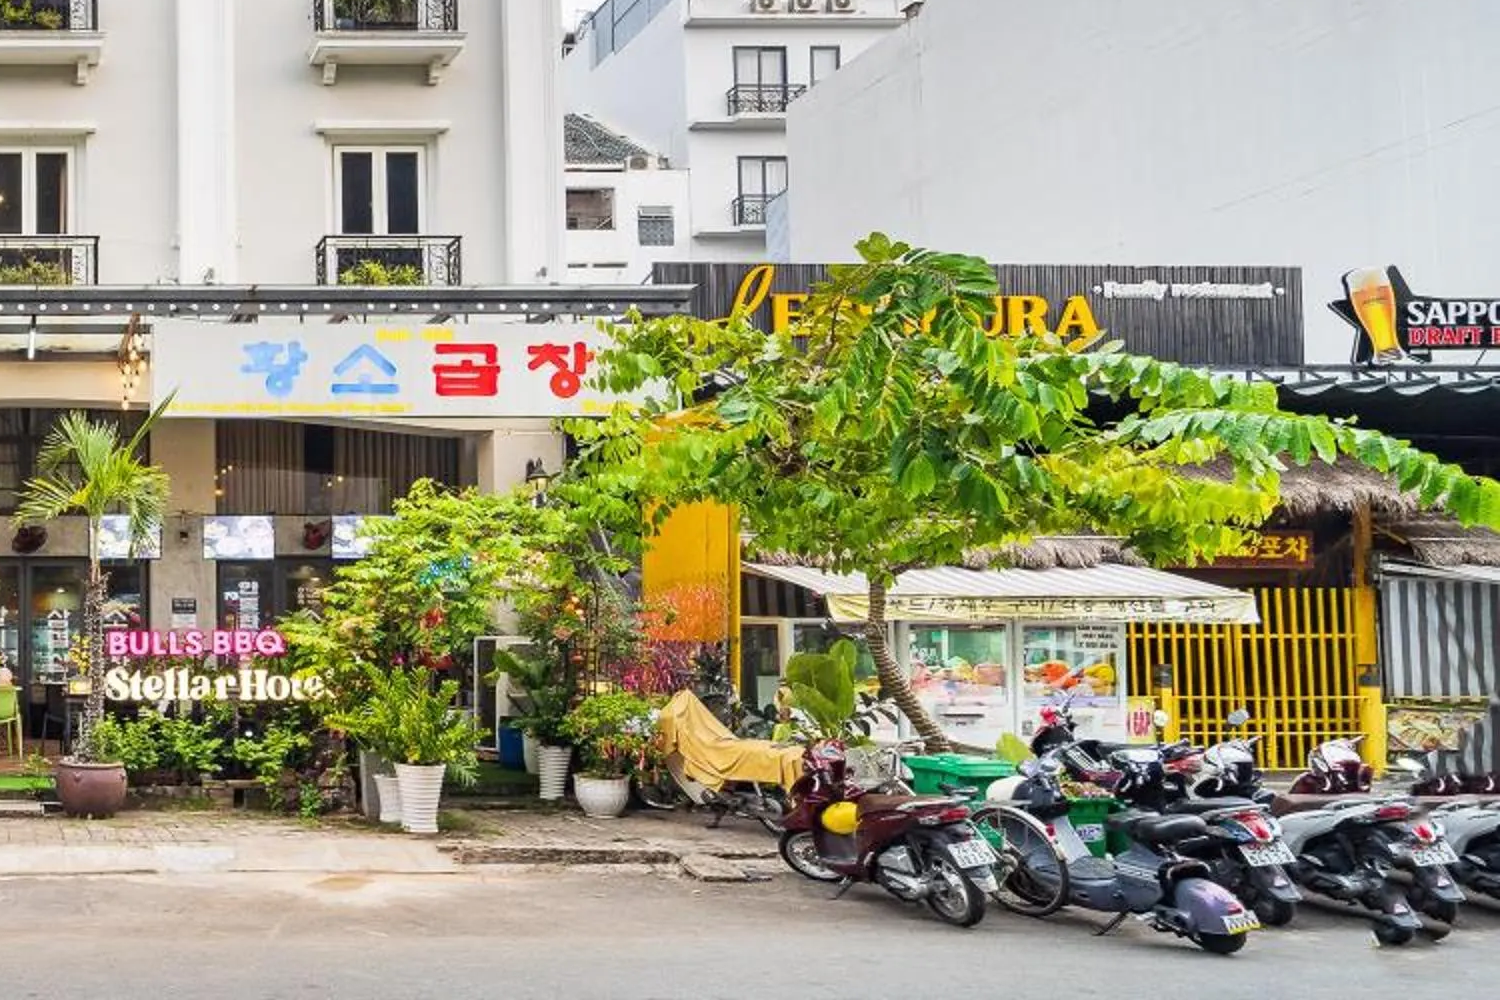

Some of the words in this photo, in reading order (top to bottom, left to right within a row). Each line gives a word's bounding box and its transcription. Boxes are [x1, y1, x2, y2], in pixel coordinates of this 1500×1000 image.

[1409, 326, 1482, 345] DRAFT
[108, 631, 203, 656] BULLS
[213, 629, 285, 655] BBQ
[105, 667, 238, 701] Stellar
